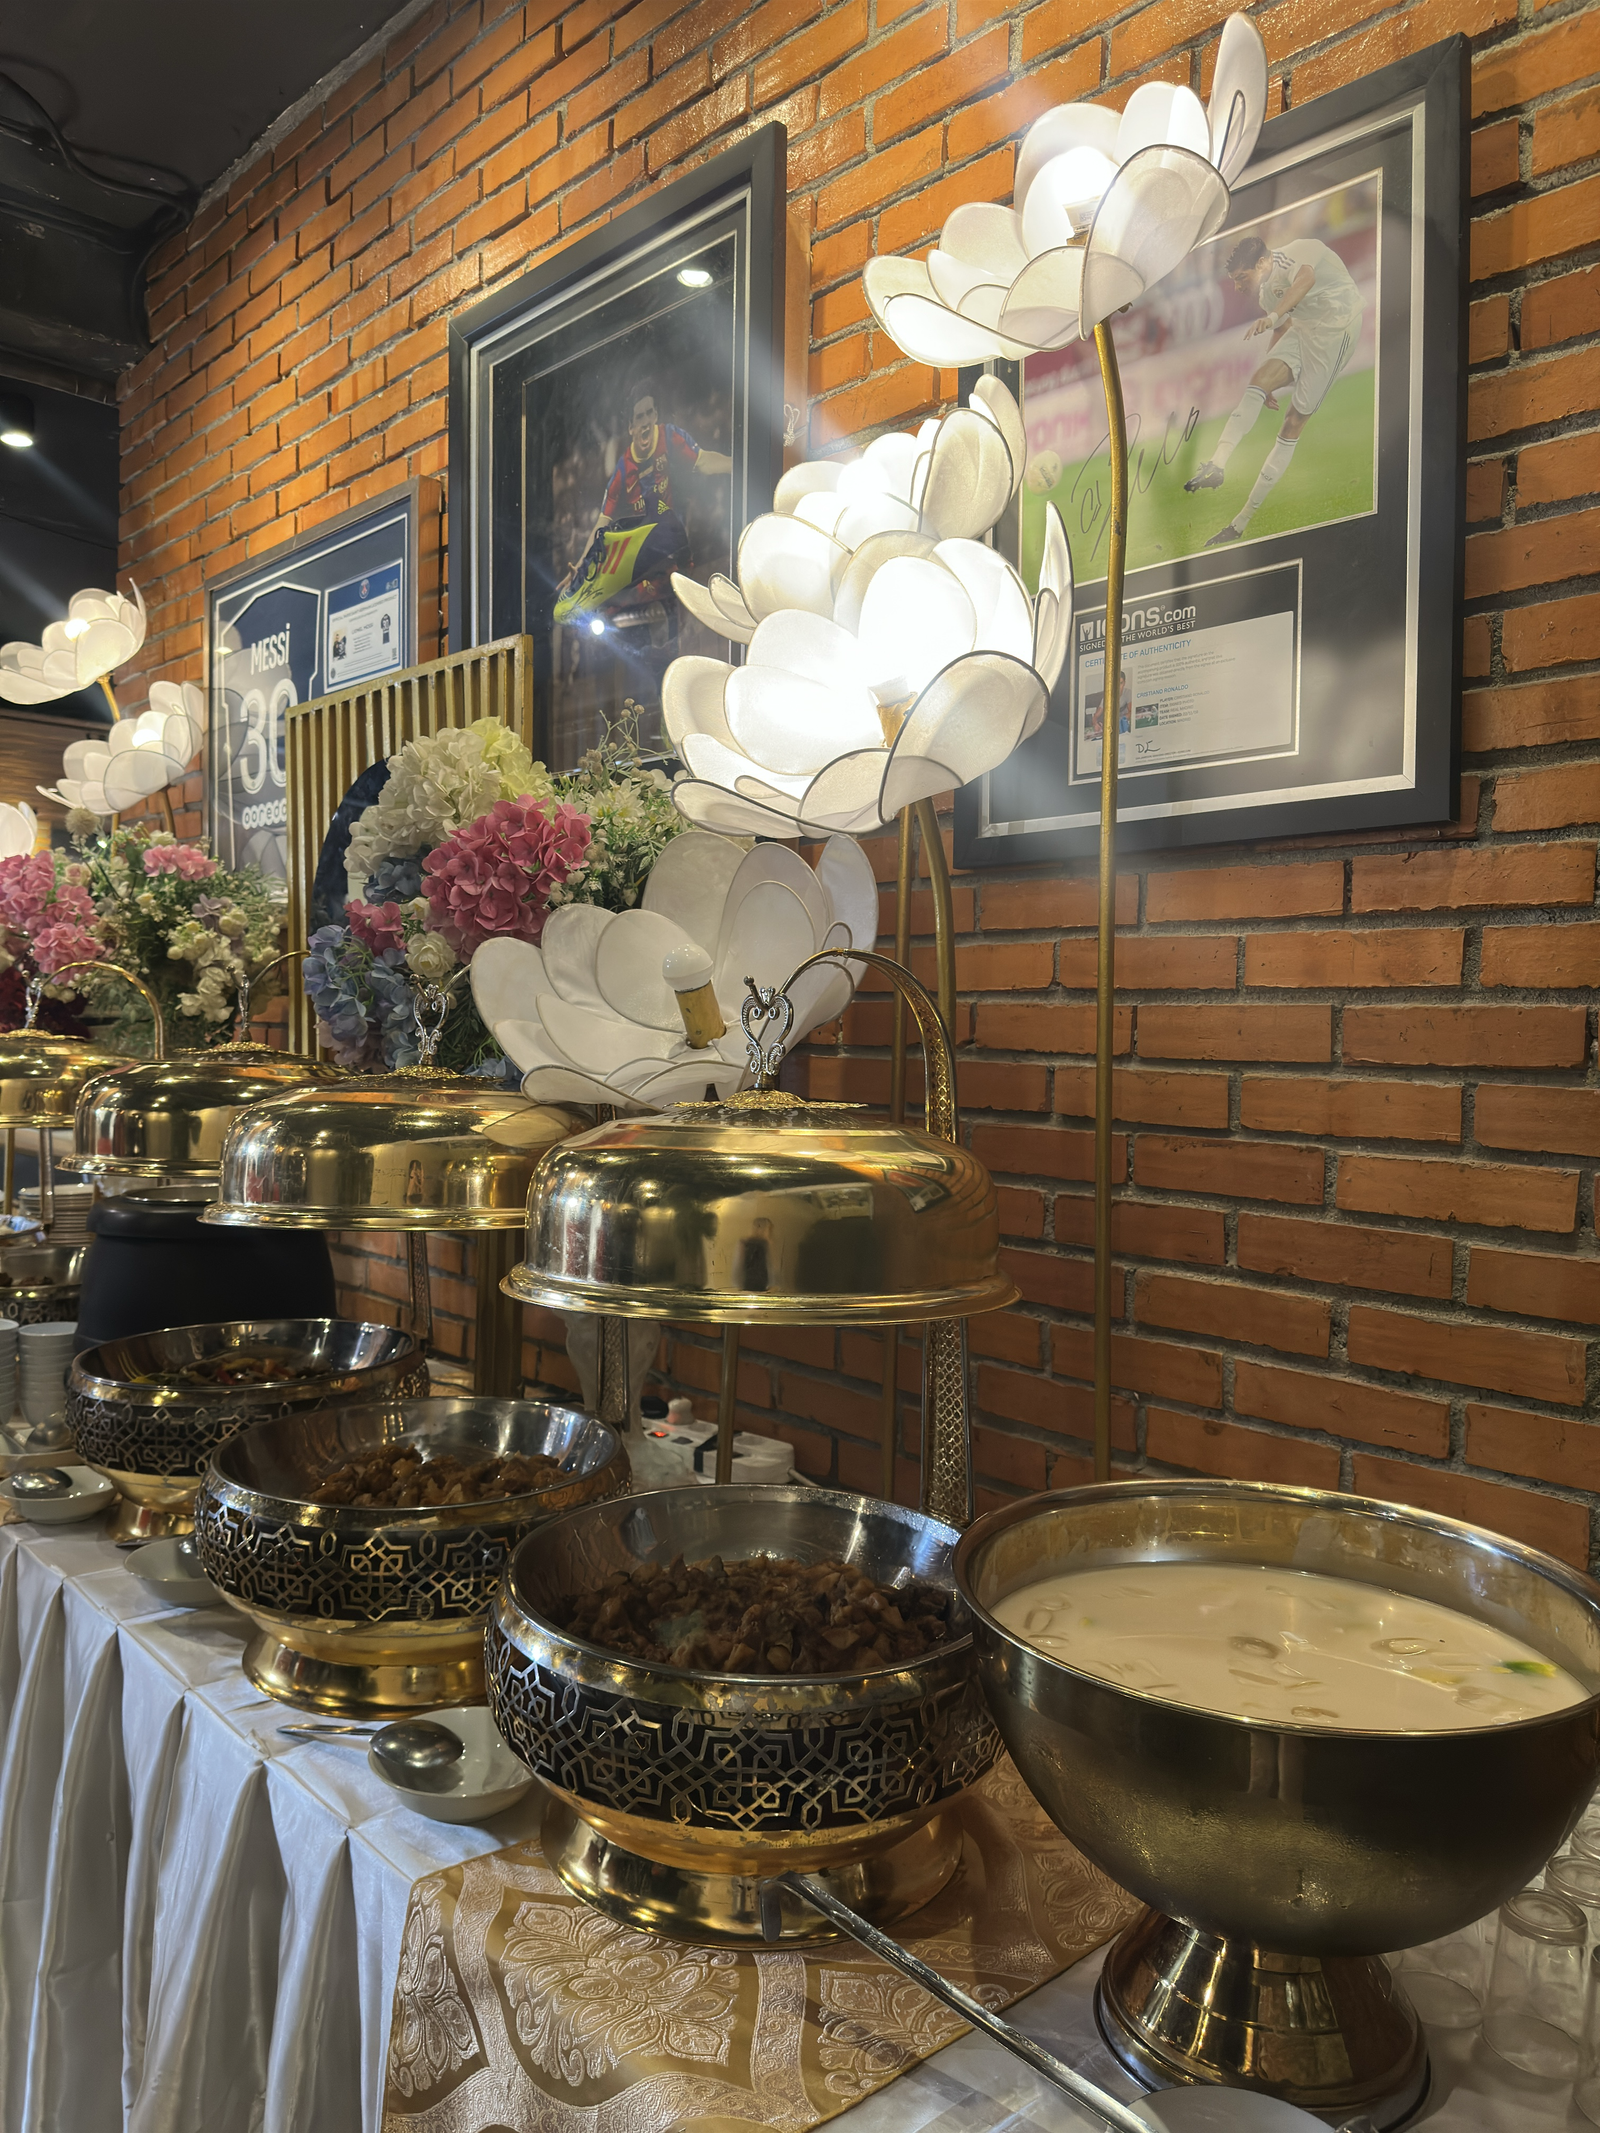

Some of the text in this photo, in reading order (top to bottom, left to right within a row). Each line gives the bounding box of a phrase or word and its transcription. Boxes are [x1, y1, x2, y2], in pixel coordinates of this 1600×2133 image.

[1121, 633, 1136, 643] THE
[1137, 626, 1174, 640] WORLD'S
[1176, 620, 1196, 631] BEST
[1129, 650, 1138, 659] OF
[1140, 639, 1192, 657] AUTHENTICITY
[1136, 684, 1189, 698] CRISTIANO RONALDO
[240, 678, 298, 795] 30
